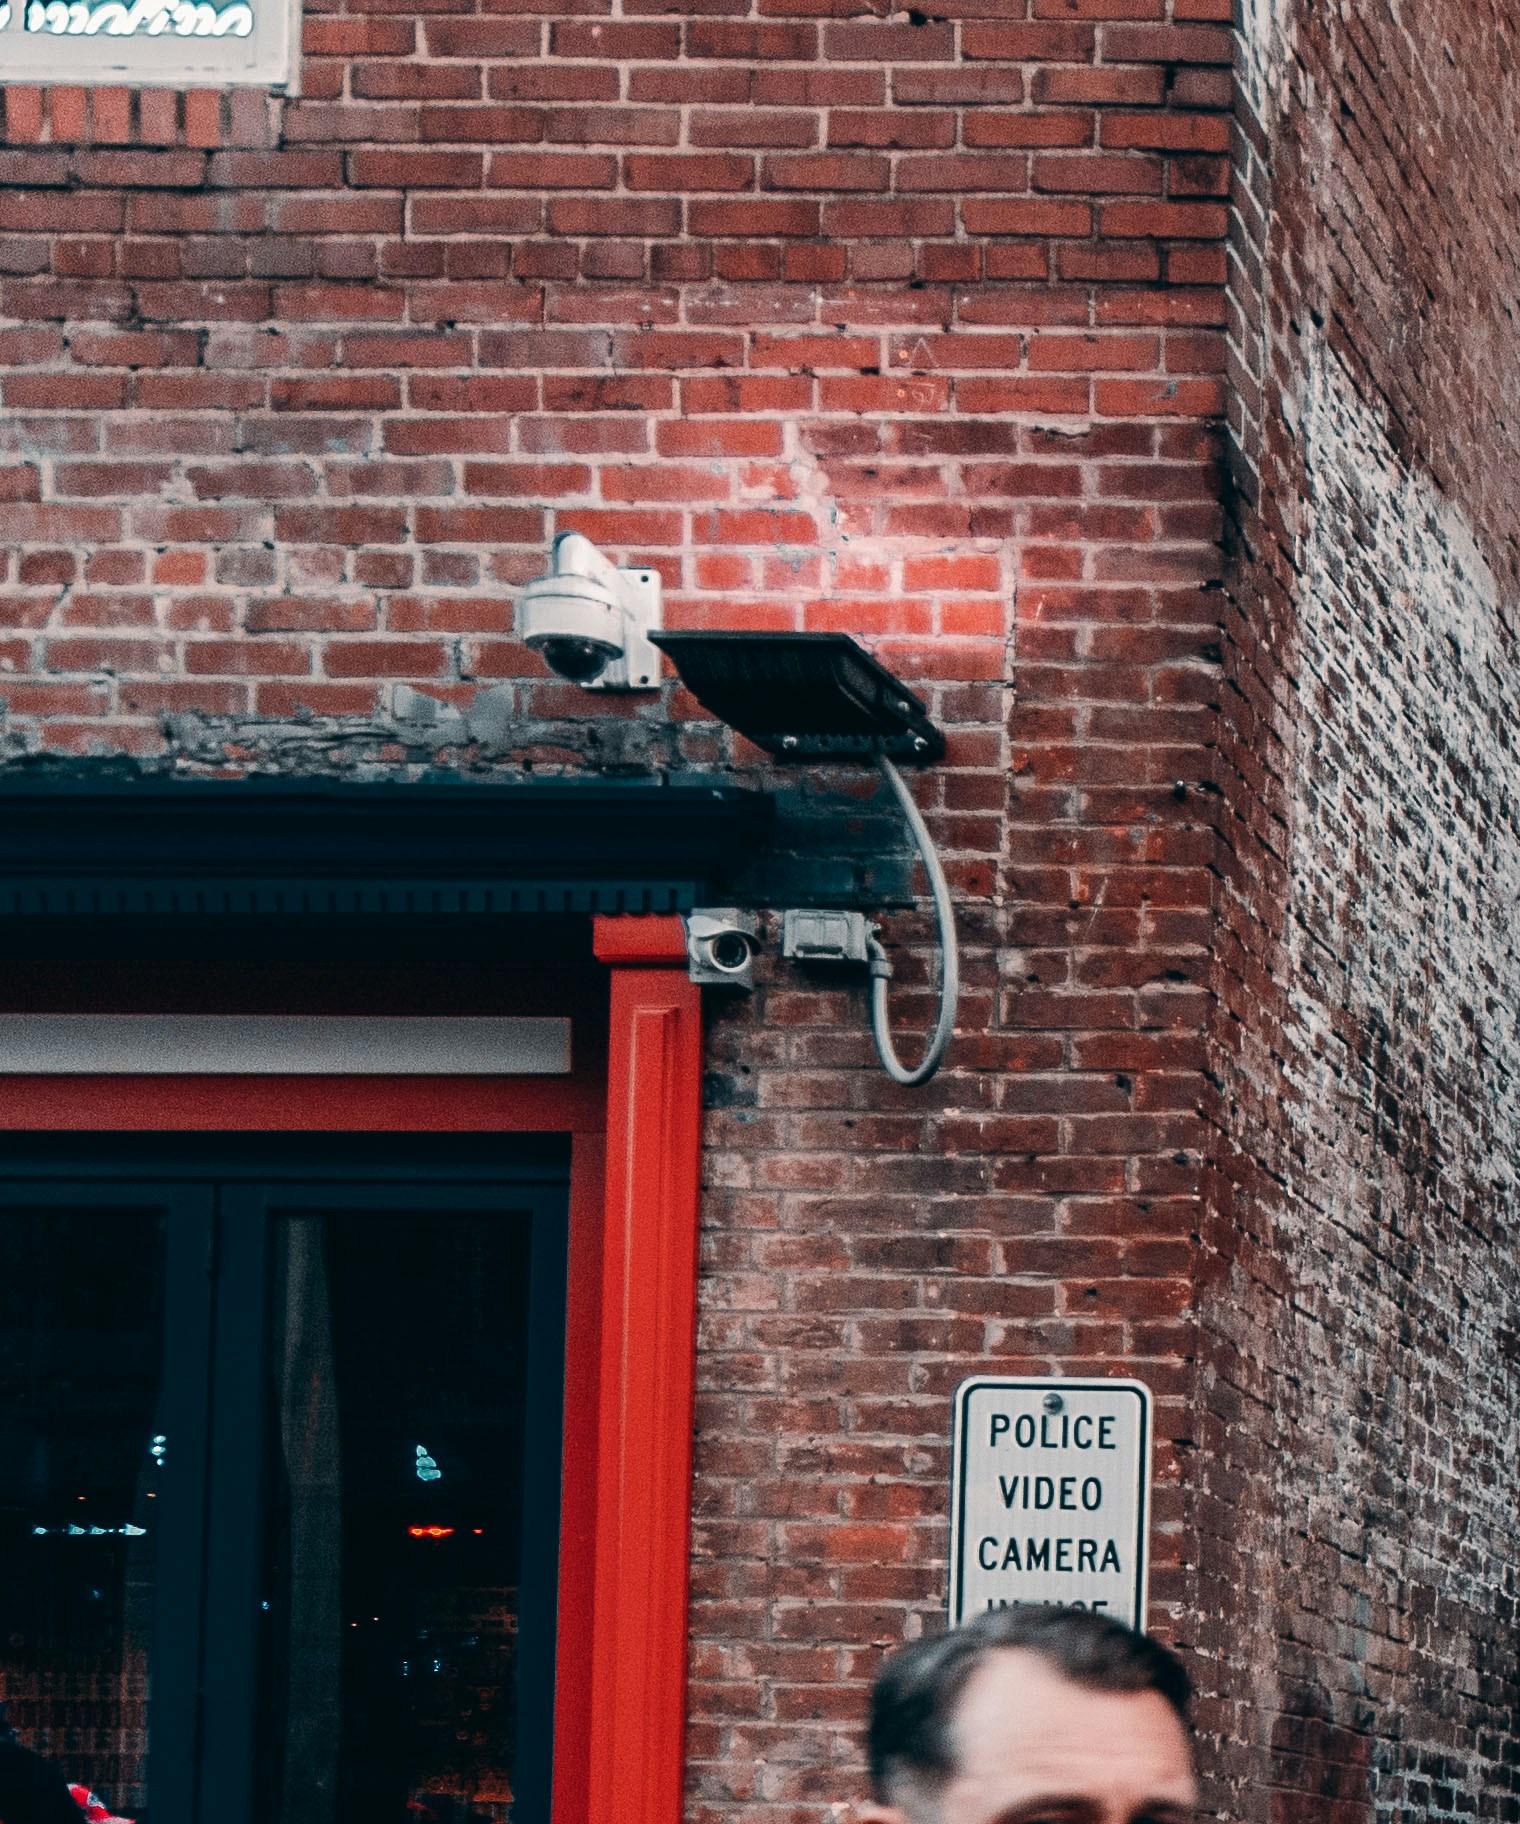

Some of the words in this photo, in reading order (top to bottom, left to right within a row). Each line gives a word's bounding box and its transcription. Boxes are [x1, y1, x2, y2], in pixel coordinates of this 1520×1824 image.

[989, 1413, 1116, 1450] POLICE
[998, 1475, 1102, 1511] VIDEO
[978, 1536, 1121, 1573] CAMERA
